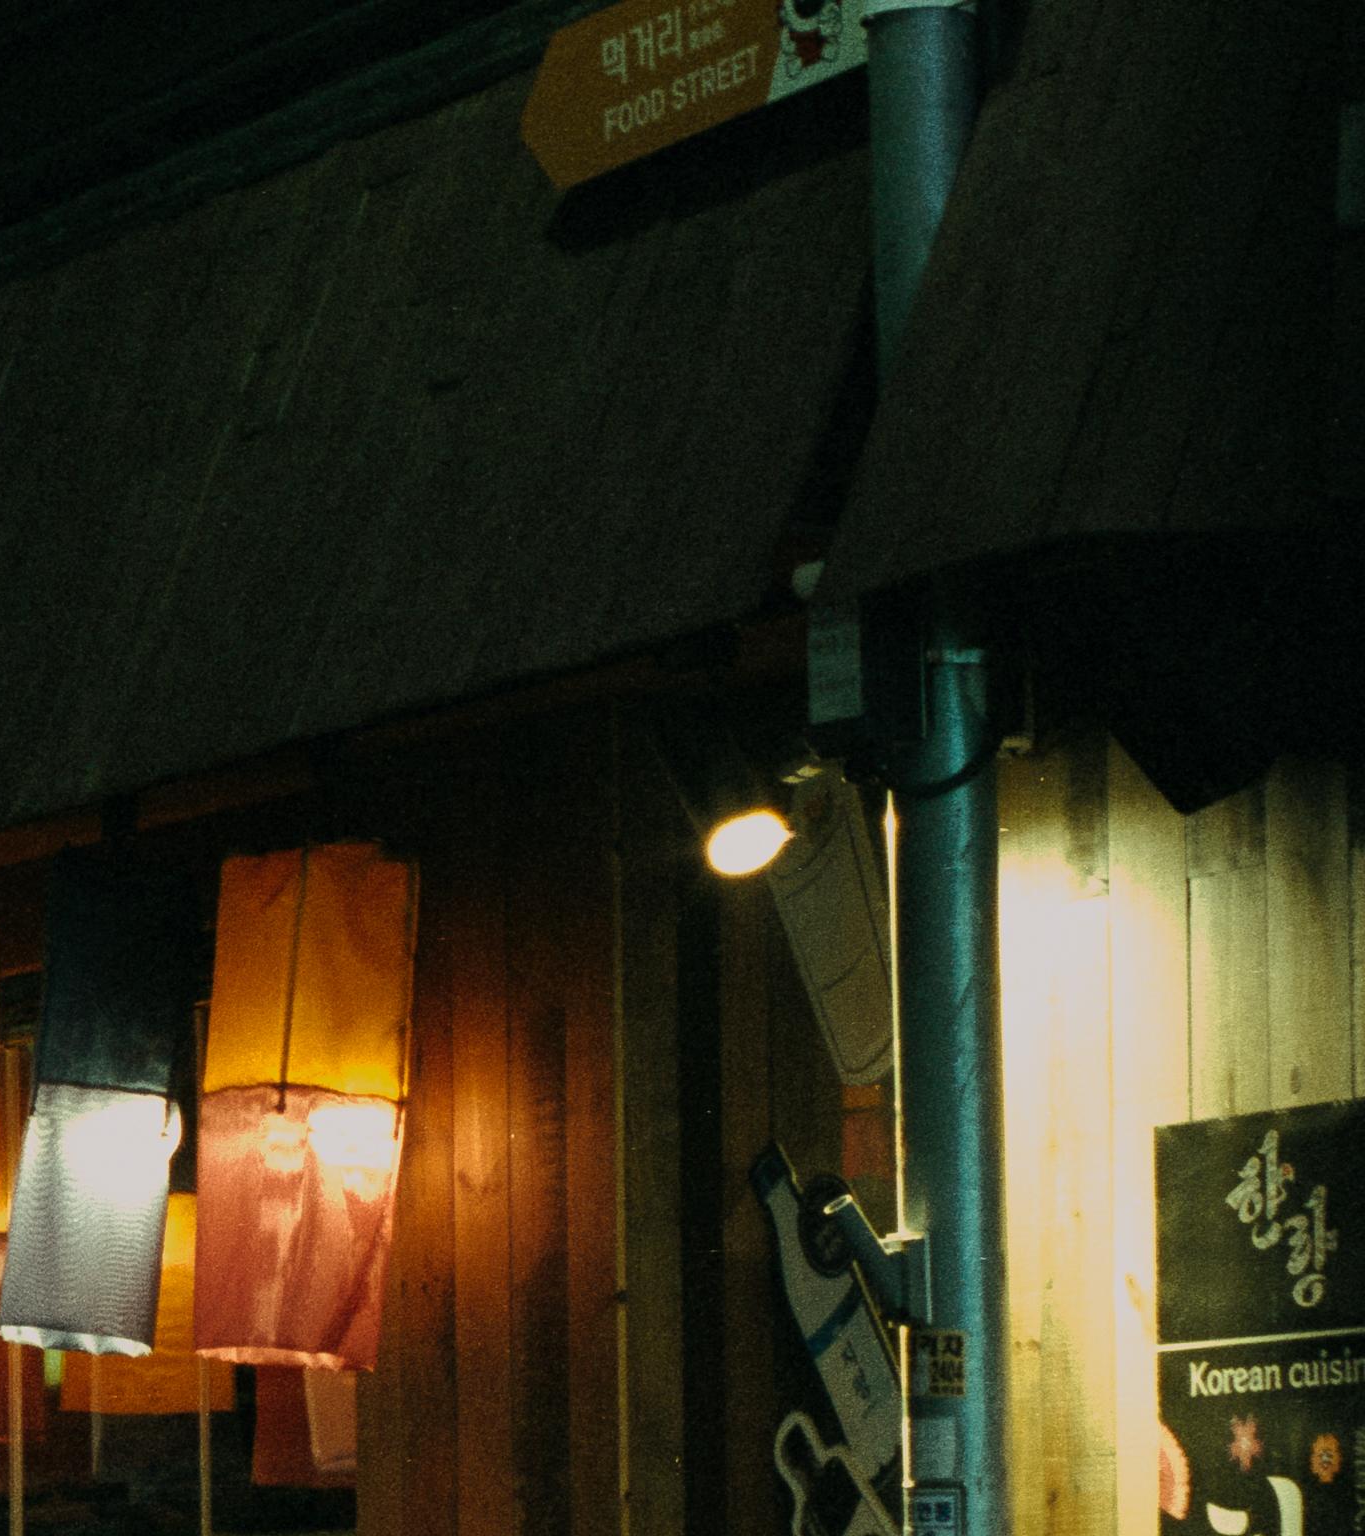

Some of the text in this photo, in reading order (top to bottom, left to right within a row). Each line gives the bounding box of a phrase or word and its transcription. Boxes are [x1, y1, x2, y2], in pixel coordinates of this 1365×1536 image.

[600, 8, 683, 84] 먹거리
[603, 44, 761, 142] FOOD STREET
[1189, 1362, 1282, 1398] Korean
